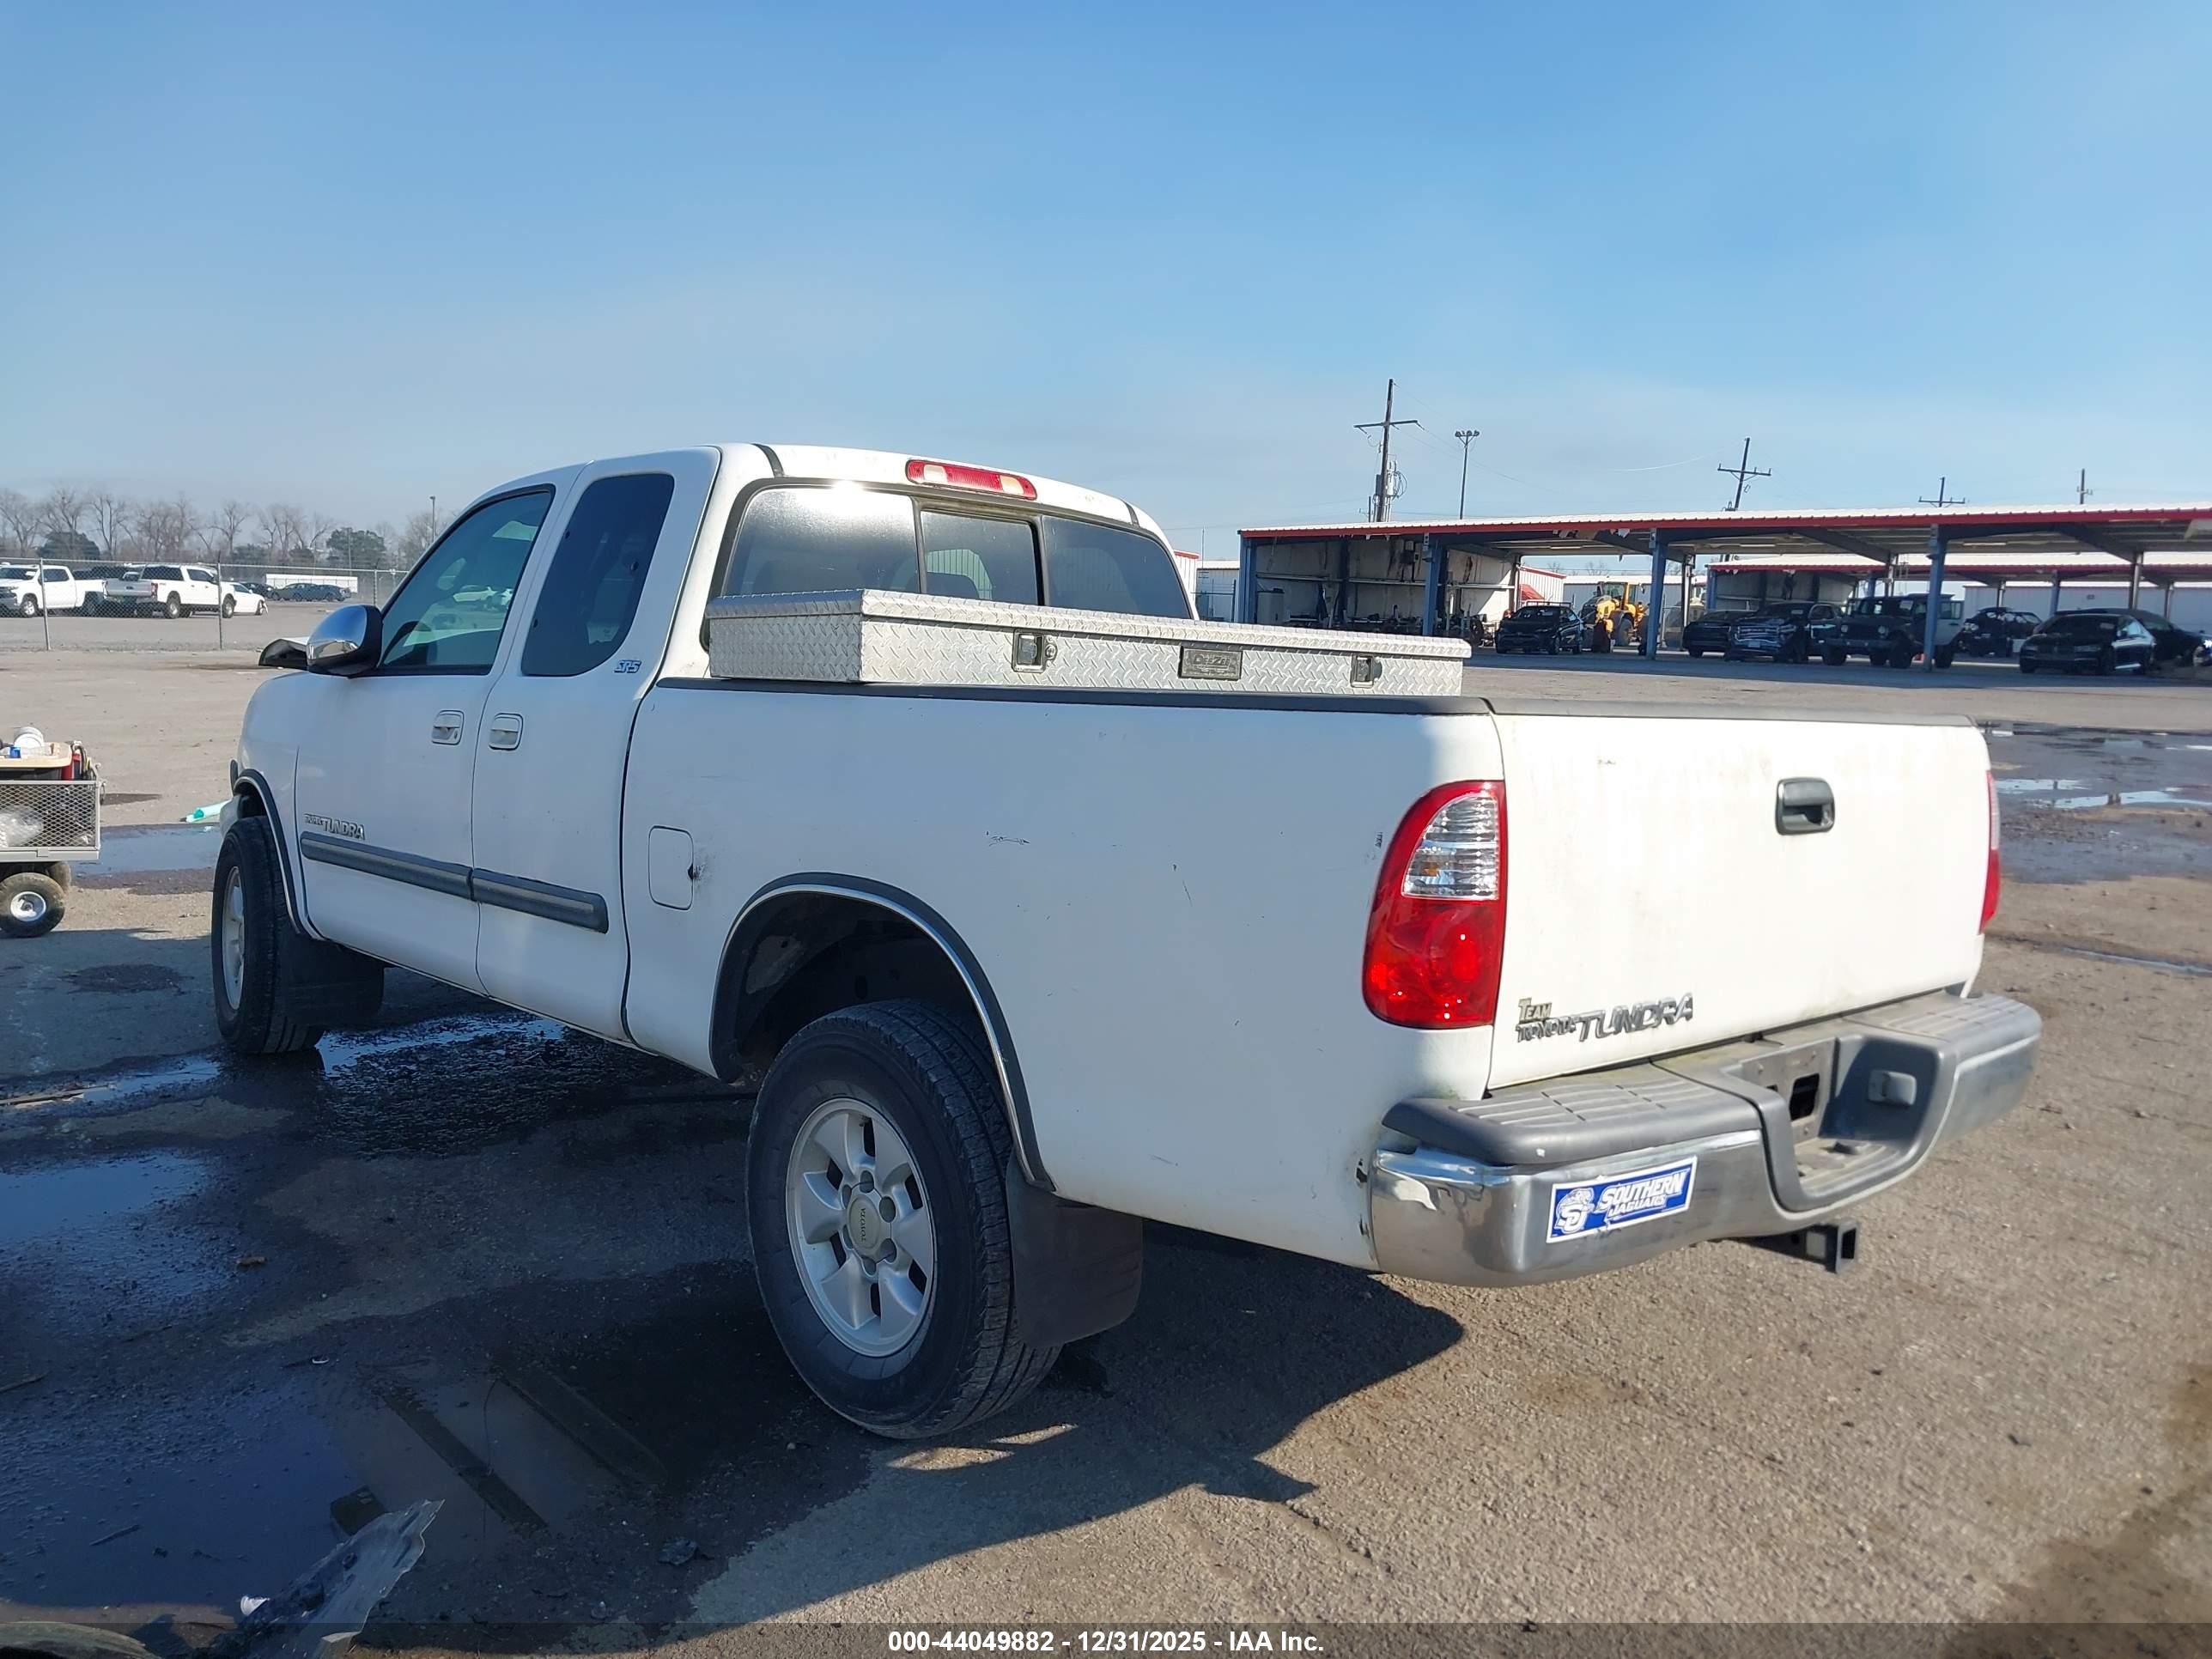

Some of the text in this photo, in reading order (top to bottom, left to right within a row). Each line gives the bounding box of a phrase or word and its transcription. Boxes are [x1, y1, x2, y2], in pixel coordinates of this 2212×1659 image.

[321, 816, 366, 841] TUNDRA
[1575, 993, 1693, 1042] TUNDRA
[1597, 1168, 1688, 1212] SOUTHERN
